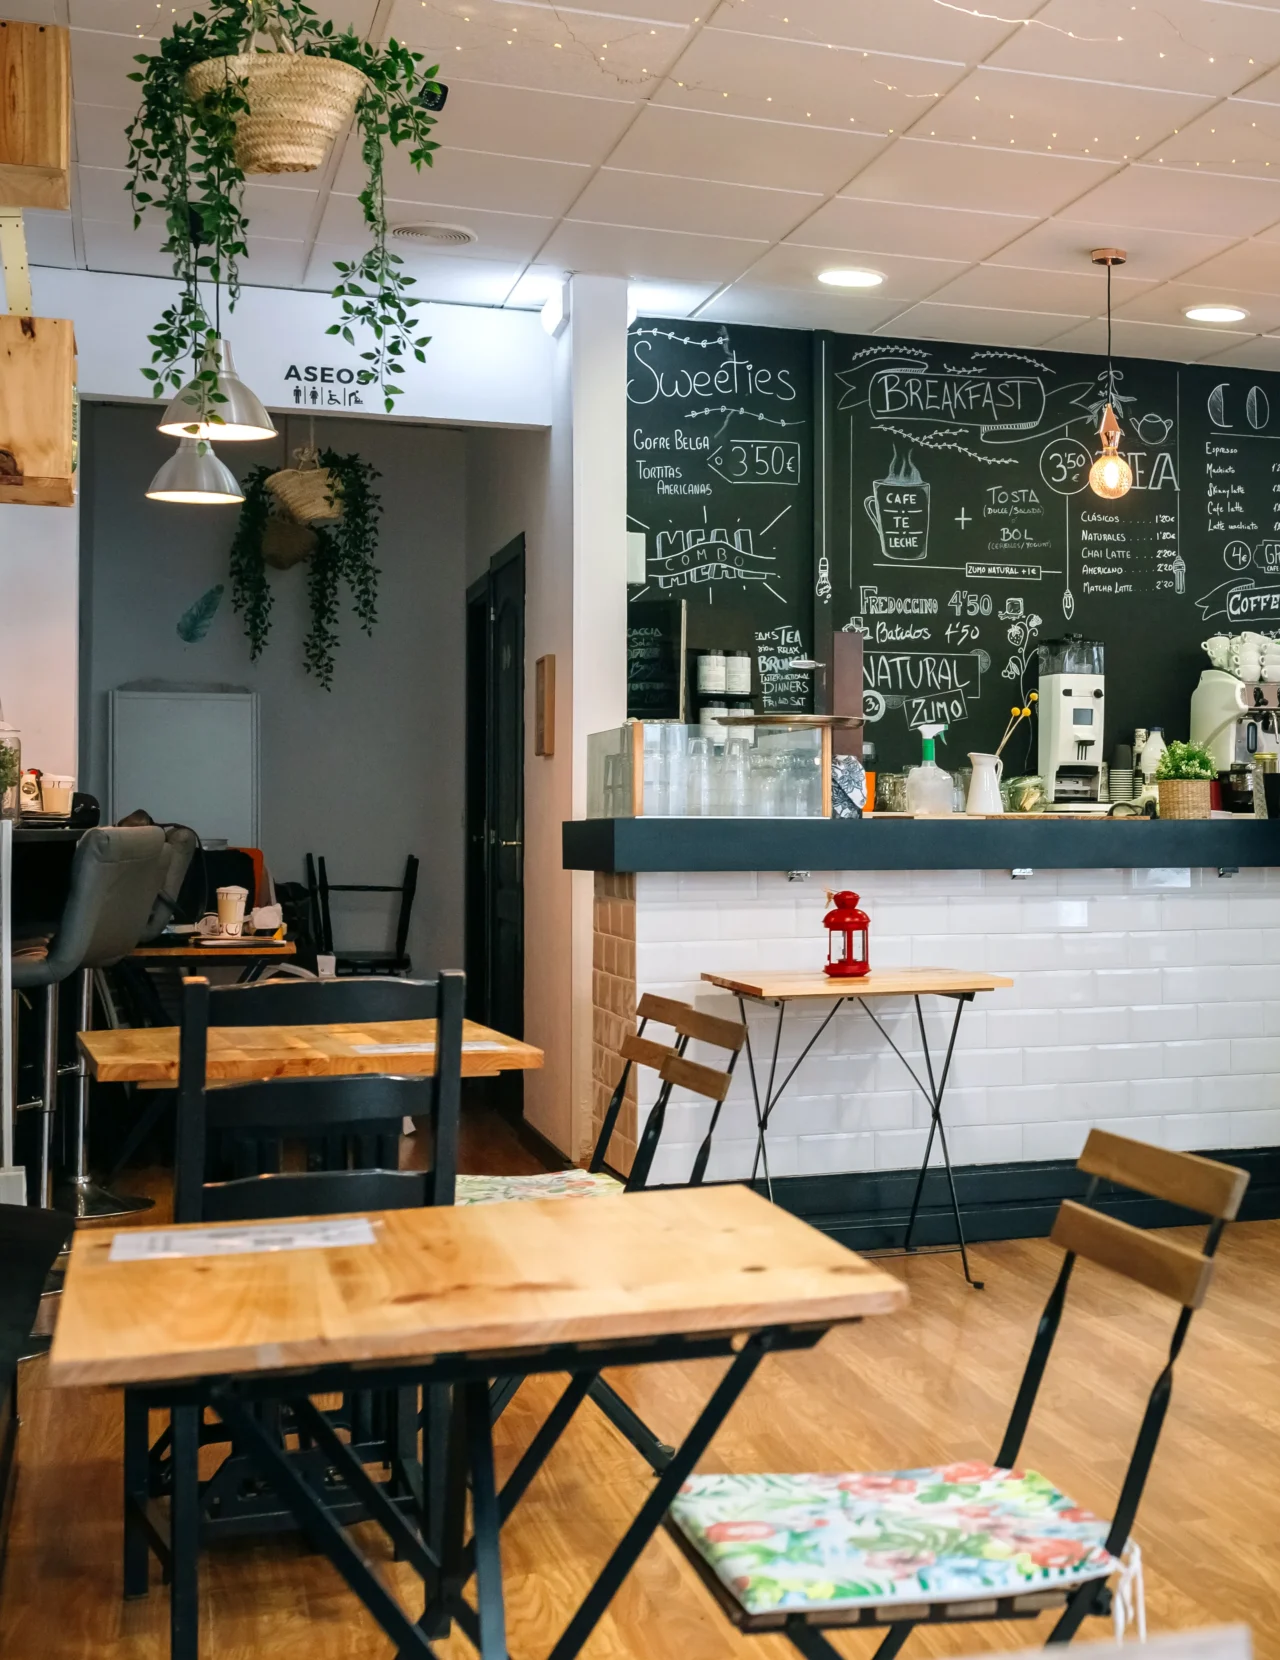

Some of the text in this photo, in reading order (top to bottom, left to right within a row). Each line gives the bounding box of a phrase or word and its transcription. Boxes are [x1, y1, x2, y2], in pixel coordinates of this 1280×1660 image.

[284, 365, 370, 385] ASEOS
[626, 340, 796, 404] Sweeties
[876, 374, 1037, 421] BREAKFAST
[633, 429, 710, 451] GOFRE BELGA
[636, 460, 682, 479] TORTITAS
[657, 480, 712, 495] AMERICANAS
[986, 486, 1040, 504] TOSTA
[886, 493, 917, 504] CAFE
[893, 516, 909, 528] TE
[889, 537, 918, 548] LECHE
[1000, 527, 1034, 542] BOL
[1081, 530, 1126, 541] NATURALES
[665, 548, 744, 571] COMBO
[1081, 547, 1103, 559] CHAI
[1105, 548, 1131, 559] LATTE
[968, 566, 986, 574] ZUMO
[988, 566, 1019, 575] NATURAL
[859, 586, 938, 615] FREDOCCINO
[774, 625, 803, 647] TEA
[876, 621, 931, 644] Batidos
[863, 655, 970, 689] NATURAL
[762, 681, 809, 694] DINNERS
[910, 699, 962, 727] ZUMO
